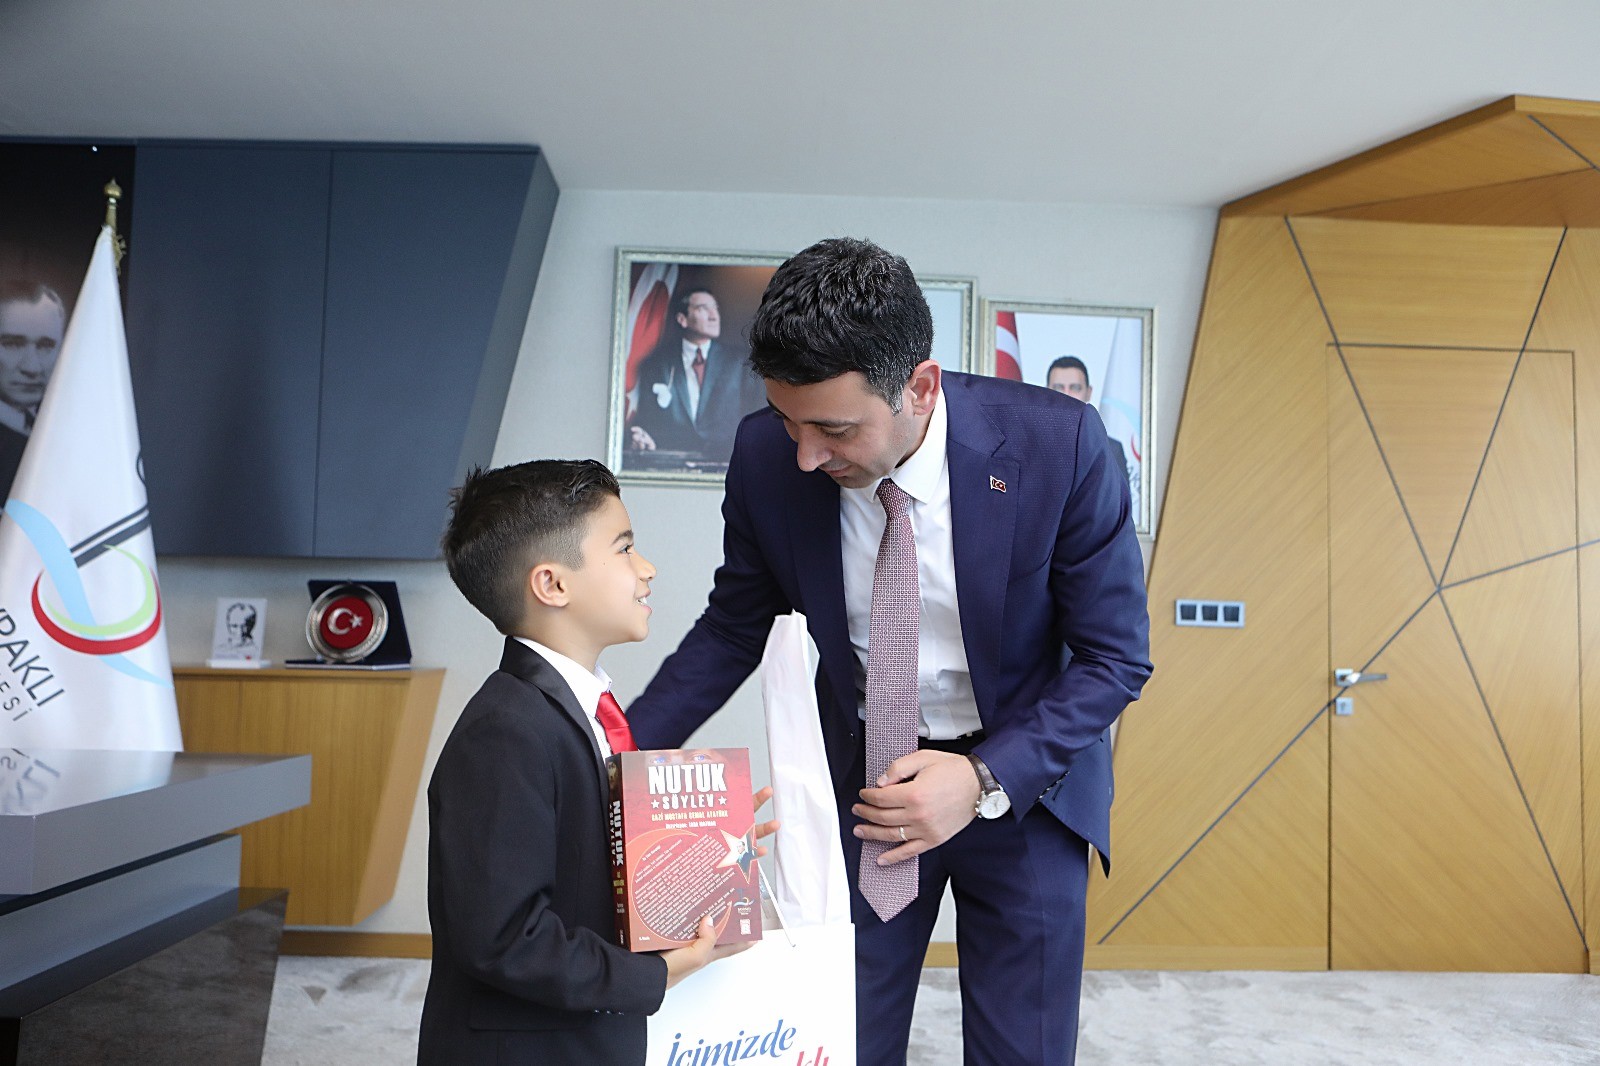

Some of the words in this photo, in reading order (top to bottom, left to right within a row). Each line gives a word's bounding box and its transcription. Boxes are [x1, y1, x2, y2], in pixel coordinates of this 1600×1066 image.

[0, 608, 65, 706] PAKLI
[648, 763, 727, 794] NUTUK
[662, 793, 714, 810] SÖYLEV
[613, 800, 624, 867] NUTUK
